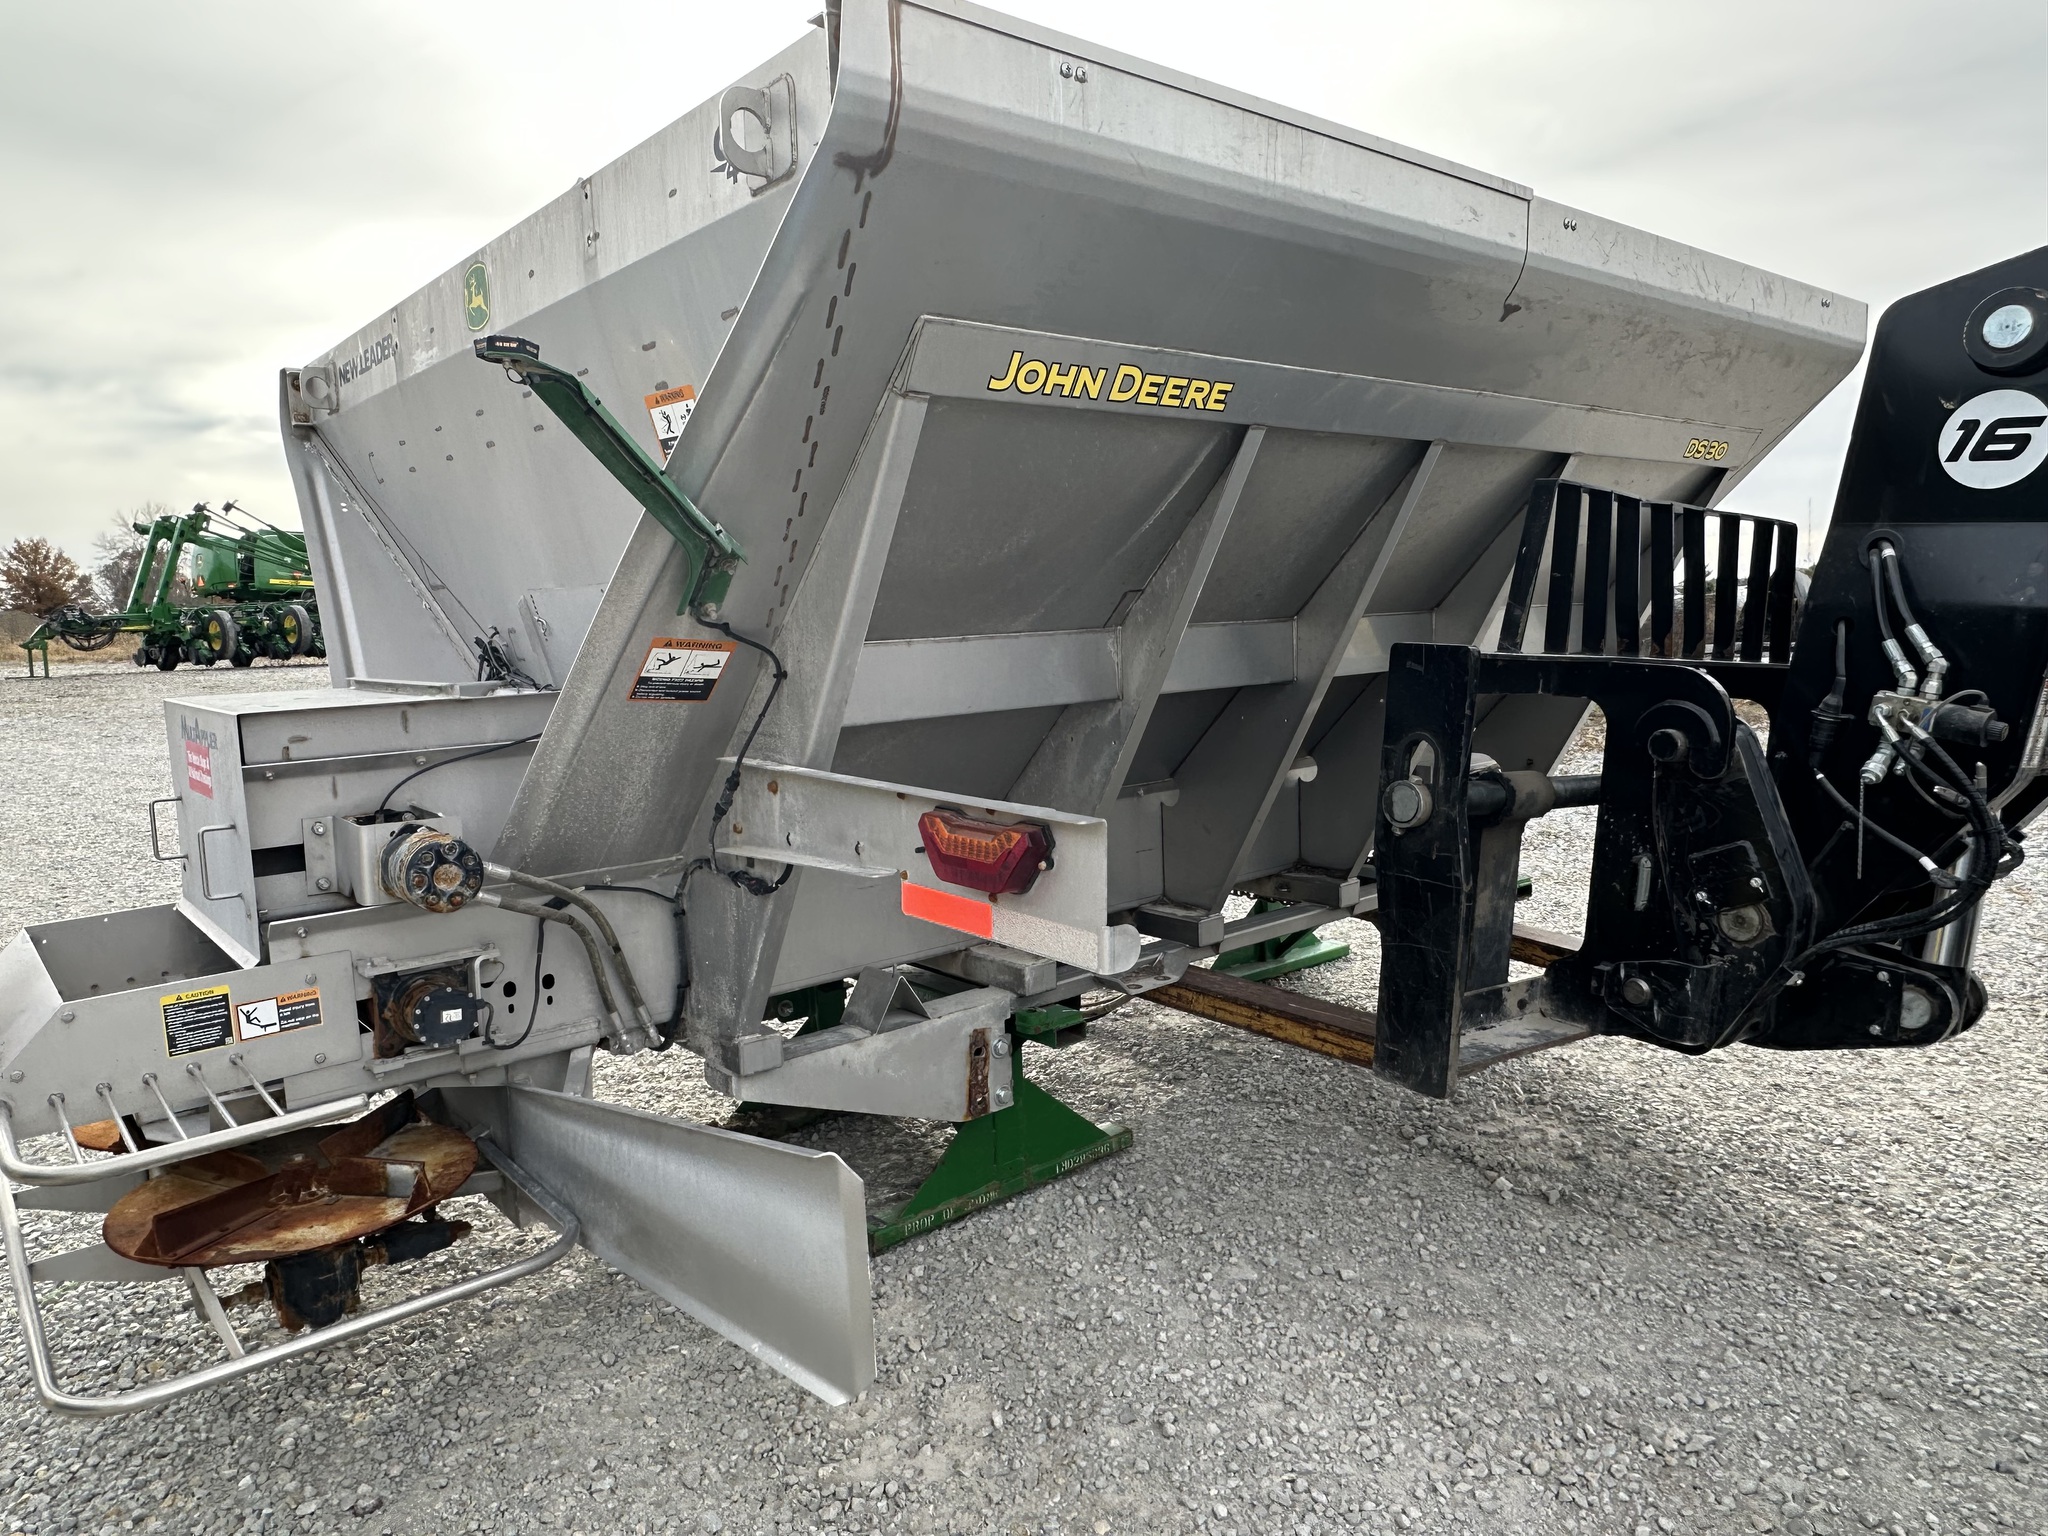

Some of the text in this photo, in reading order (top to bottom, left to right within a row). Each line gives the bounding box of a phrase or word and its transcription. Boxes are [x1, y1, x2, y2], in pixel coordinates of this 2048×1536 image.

[338, 333, 395, 387] NEW LEADER
[987, 350, 1234, 412] JOHN DEERE
[1944, 415, 2048, 463] 16
[676, 641, 722, 650] WARNING
[185, 989, 214, 999] CAUTION
